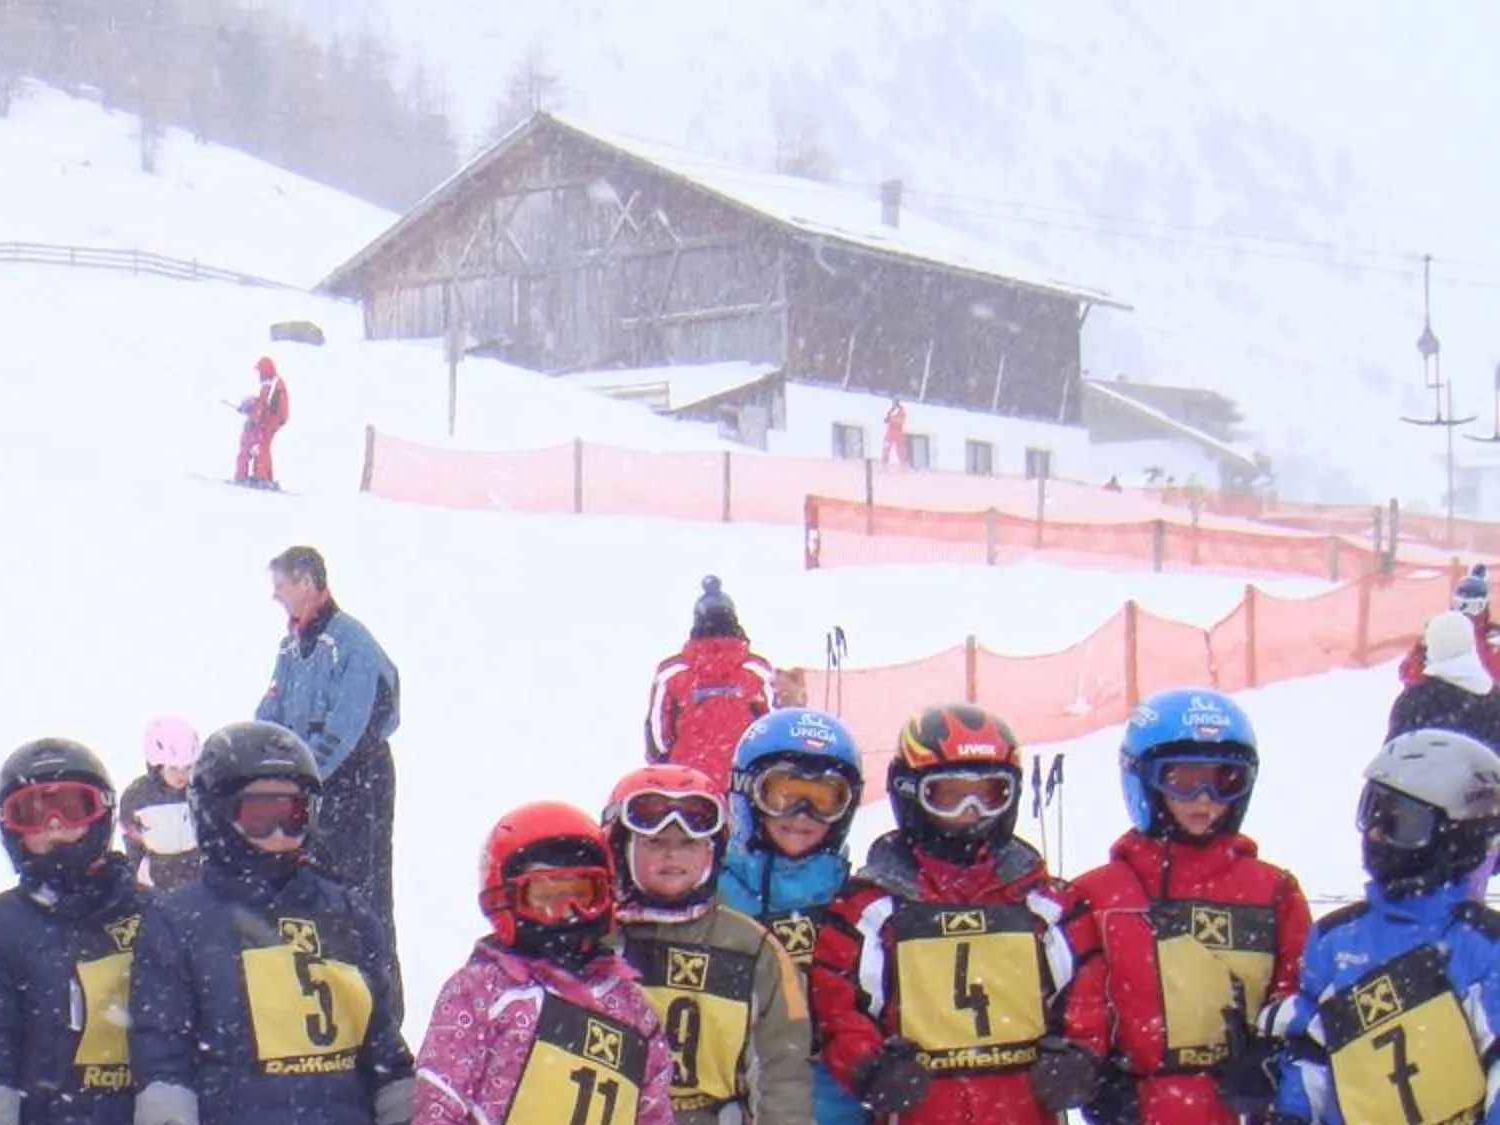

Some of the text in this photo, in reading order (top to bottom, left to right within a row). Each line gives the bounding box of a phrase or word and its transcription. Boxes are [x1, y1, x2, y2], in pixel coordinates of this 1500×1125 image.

[292, 950, 339, 1046] 5
[954, 942, 991, 1038] 4
[665, 996, 700, 1088] 9
